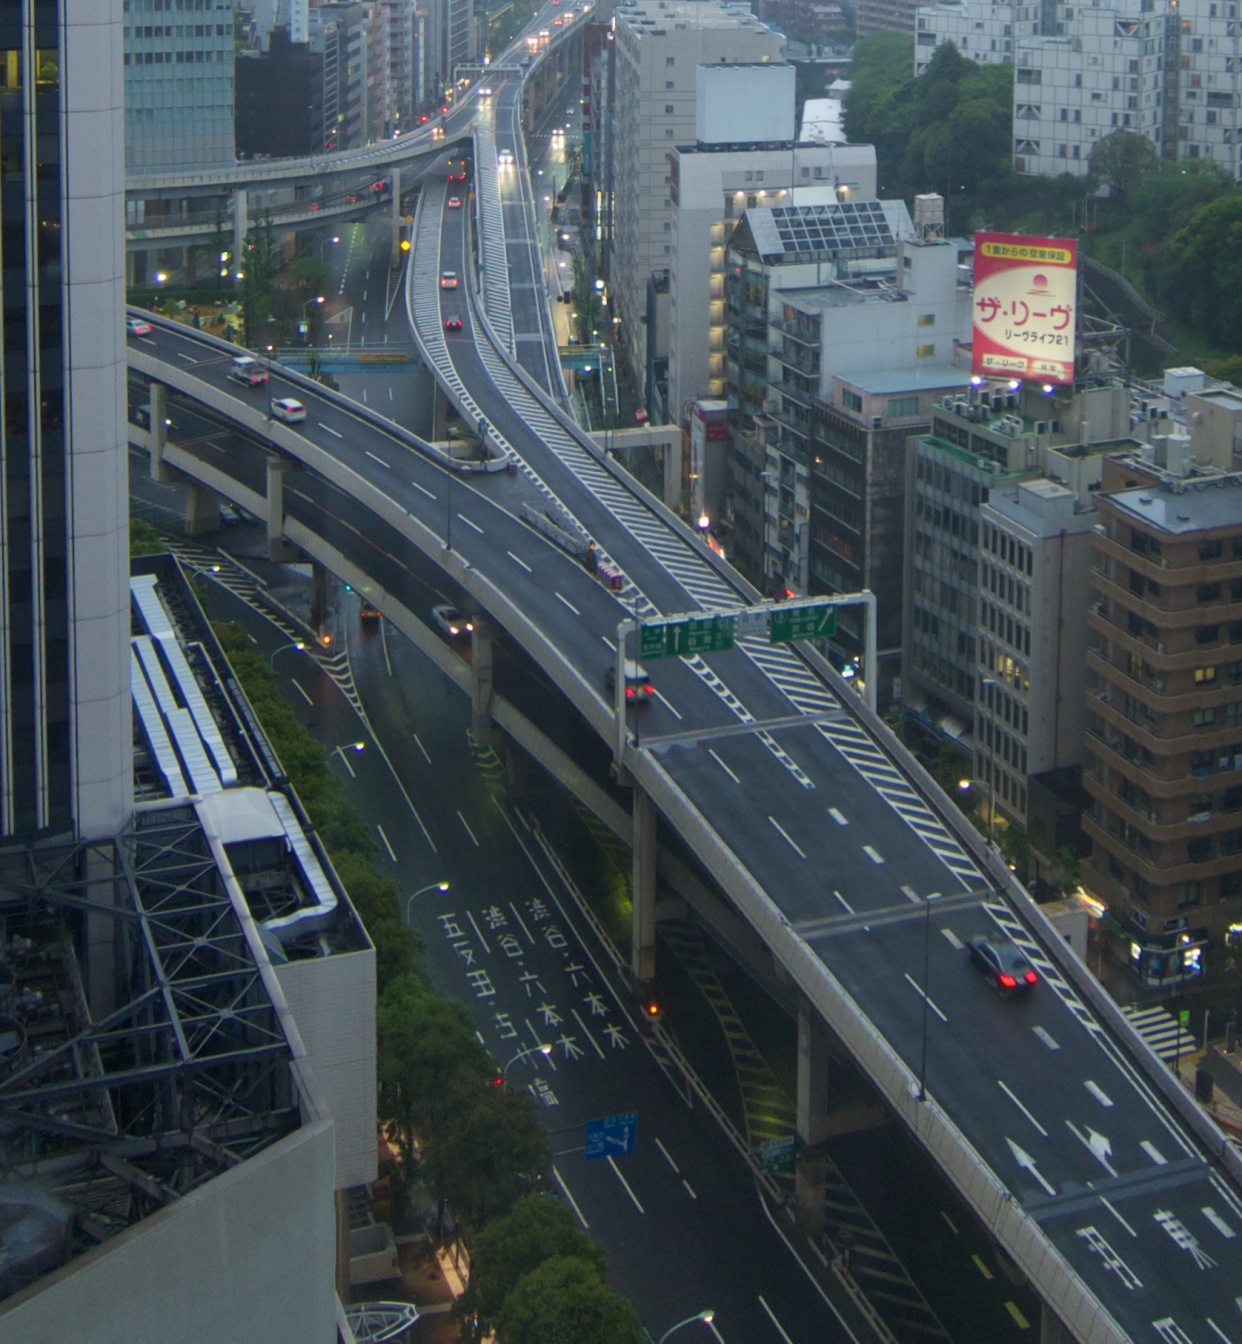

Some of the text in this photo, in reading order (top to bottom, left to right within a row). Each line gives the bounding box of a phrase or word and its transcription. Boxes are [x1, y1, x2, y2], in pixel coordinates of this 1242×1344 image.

[976, 297, 1073, 331] ザ・リーヴ
